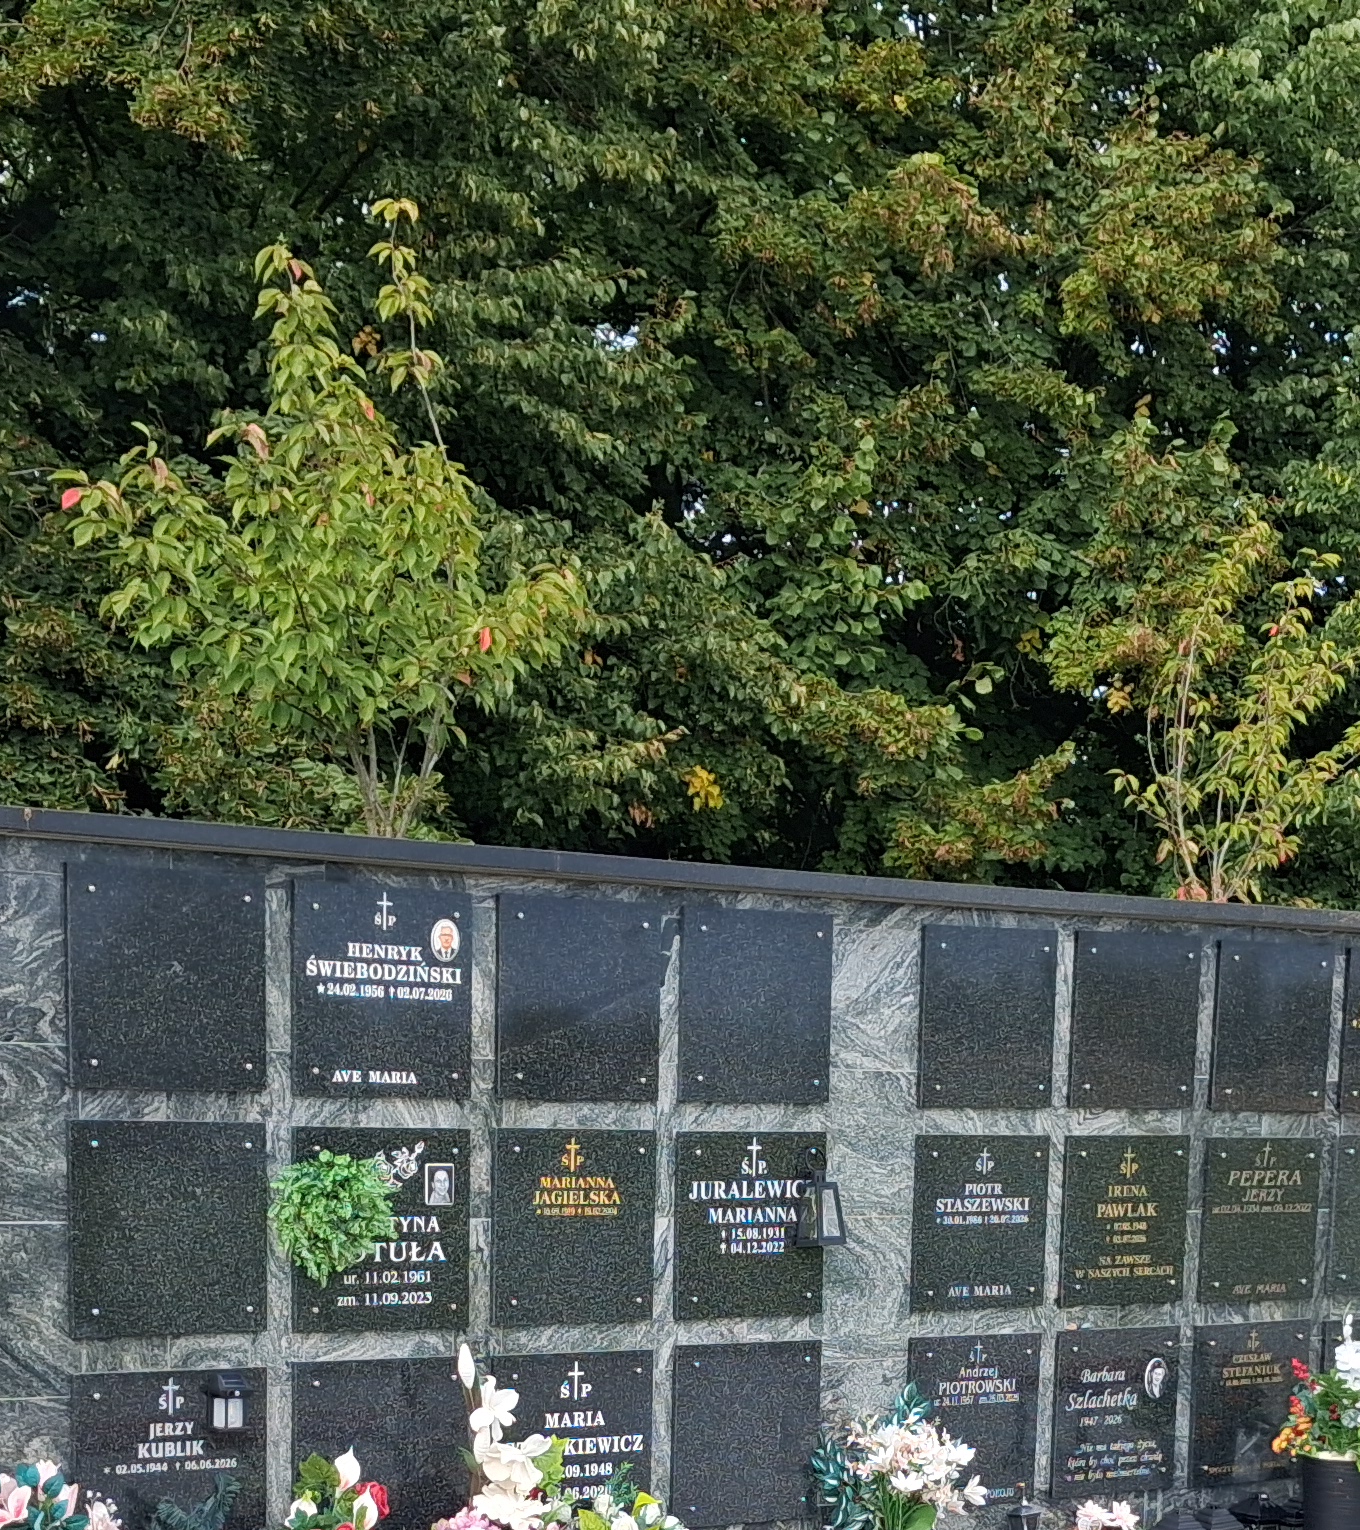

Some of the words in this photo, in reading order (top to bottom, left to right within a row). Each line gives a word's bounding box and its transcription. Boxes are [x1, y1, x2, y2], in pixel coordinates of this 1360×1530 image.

[387, 914, 397, 926] P
[347, 942, 423, 961] HENRYK
[305, 955, 462, 985] ŚWIEBODZIŃSKI
[331, 1070, 362, 1083] AVE
[368, 1071, 418, 1084] MARIA
[540, 1176, 615, 1189] MARIANNA
[1227, 1169, 1302, 1186] PEPERA
[532, 1190, 622, 1205] JAGIELSKA
[964, 1183, 1003, 1196] PIOTR
[1108, 1184, 1149, 1197] IRENA
[1242, 1188, 1285, 1202] JERZY
[935, 1197, 1030, 1213] STASZEWSKI
[1096, 1202, 1159, 1218] PAWLAK
[708, 1206, 798, 1224] MARIANNA
[343, 1272, 359, 1285] ur.
[364, 1271, 432, 1285] 11.02.1961
[948, 1286, 969, 1297] AVE
[973, 1284, 1012, 1296] MARIA
[337, 1295, 359, 1306] zm.
[1081, 1366, 1127, 1384] Barbara
[560, 1380, 570, 1399] Ś
[581, 1384, 592, 1398] P
[939, 1378, 1017, 1396] PIOTROWSKI
[175, 1396, 185, 1409] P
[1065, 1387, 1138, 1411] Szlachetka
[544, 1410, 606, 1429] MARIA
[149, 1421, 195, 1440] JERZY
[138, 1440, 206, 1459] KUBLIK
